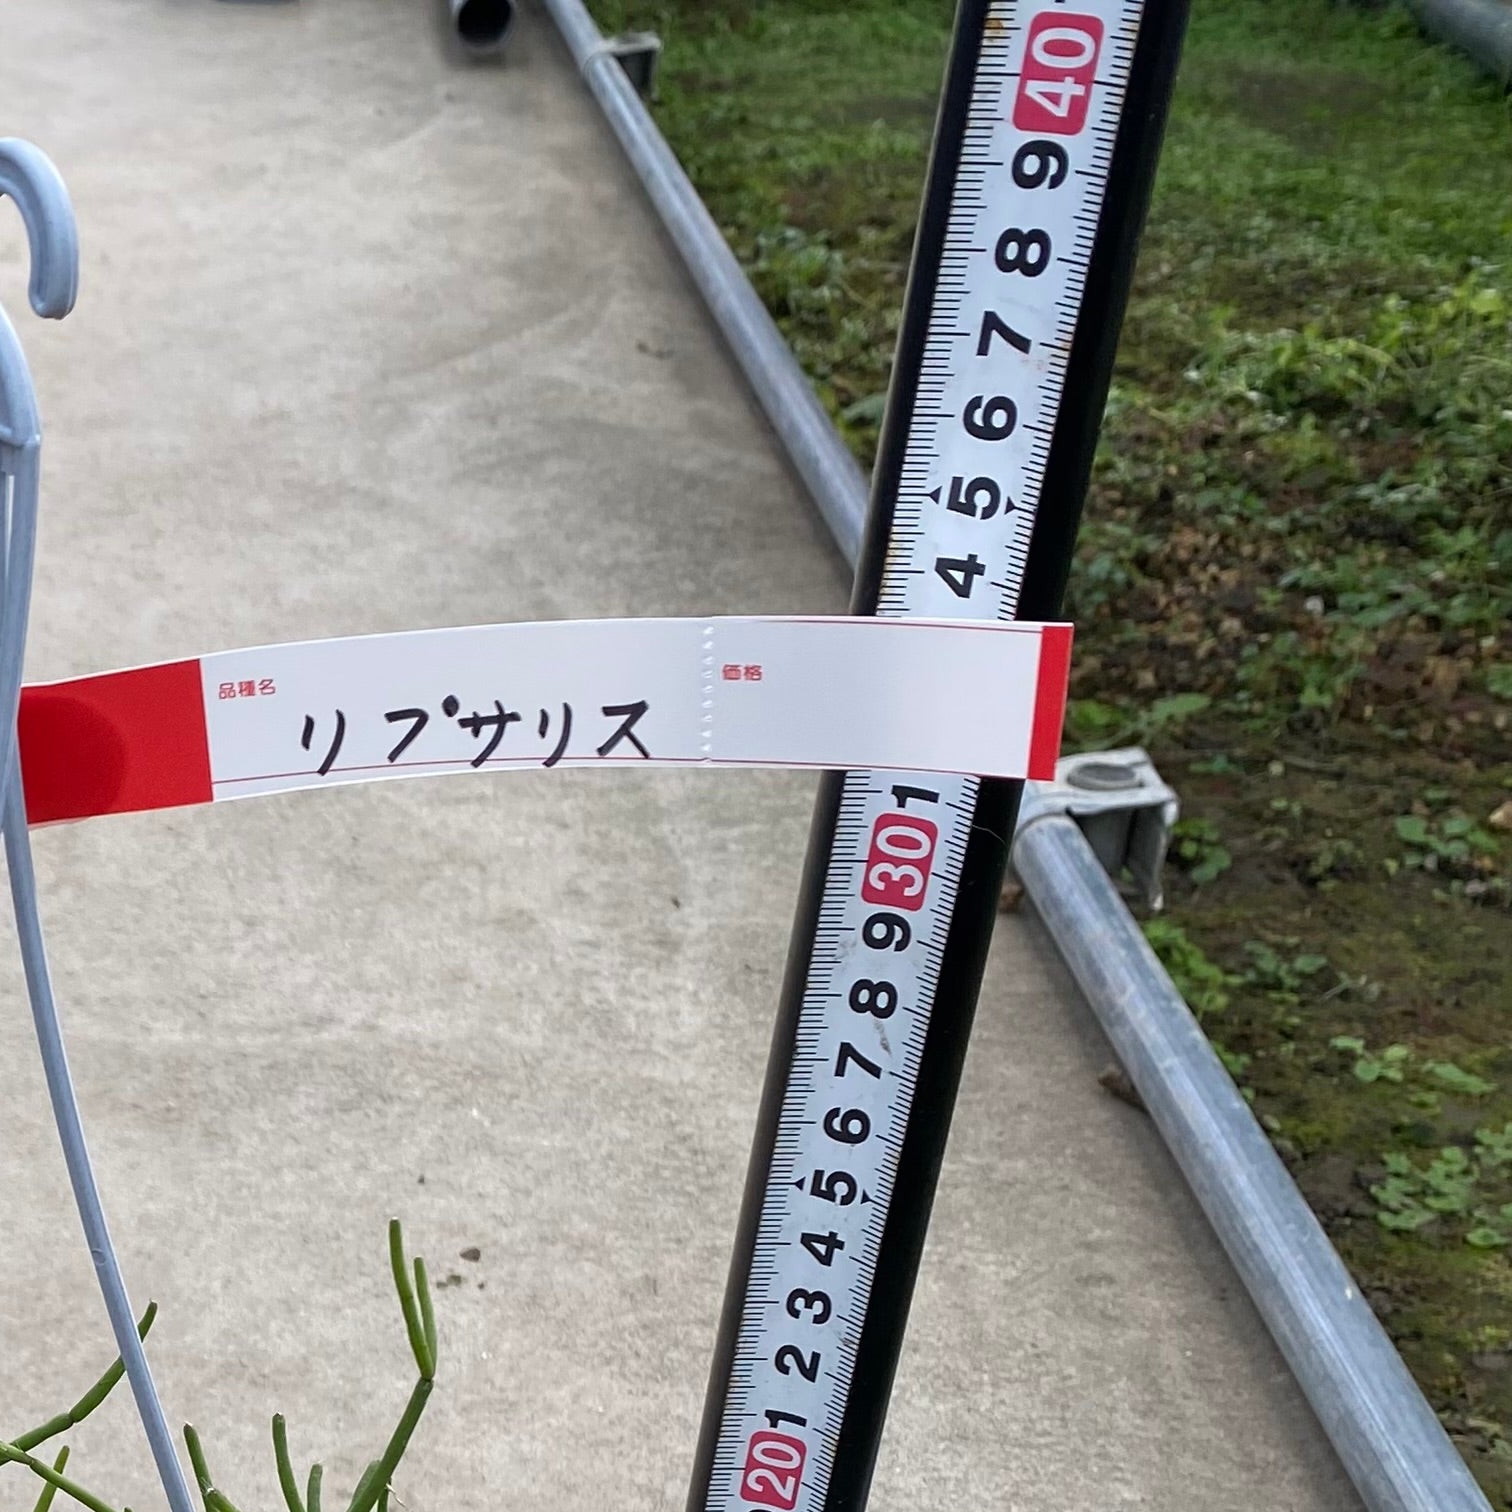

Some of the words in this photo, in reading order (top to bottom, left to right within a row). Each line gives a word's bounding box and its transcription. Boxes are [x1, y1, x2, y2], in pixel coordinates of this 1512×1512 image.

[1025, 27, 1095, 117] 40
[1012, 139, 1069, 189] 9
[995, 227, 1052, 277] 8
[976, 311, 1032, 356] 7
[963, 395, 1017, 441] 6
[947, 476, 1001, 520] 5
[935, 554, 986, 599] 4
[218, 678, 276, 699] 品種名
[722, 663, 763, 682] 価格
[300, 694, 651, 776] リプサリス
[891, 784, 940, 808] 1
[868, 825, 931, 897] 30
[862, 912, 911, 952] 9
[849, 979, 897, 1019] 8
[834, 1041, 883, 1079] 7
[823, 1107, 871, 1145] 6
[810, 1169, 857, 1206] 5
[800, 1231, 845, 1267] 4
[787, 1288, 832, 1325] 3
[774, 1345, 821, 1383] 2
[765, 1409, 807, 1428] 1
[746, 1440, 801, 1501] 20
